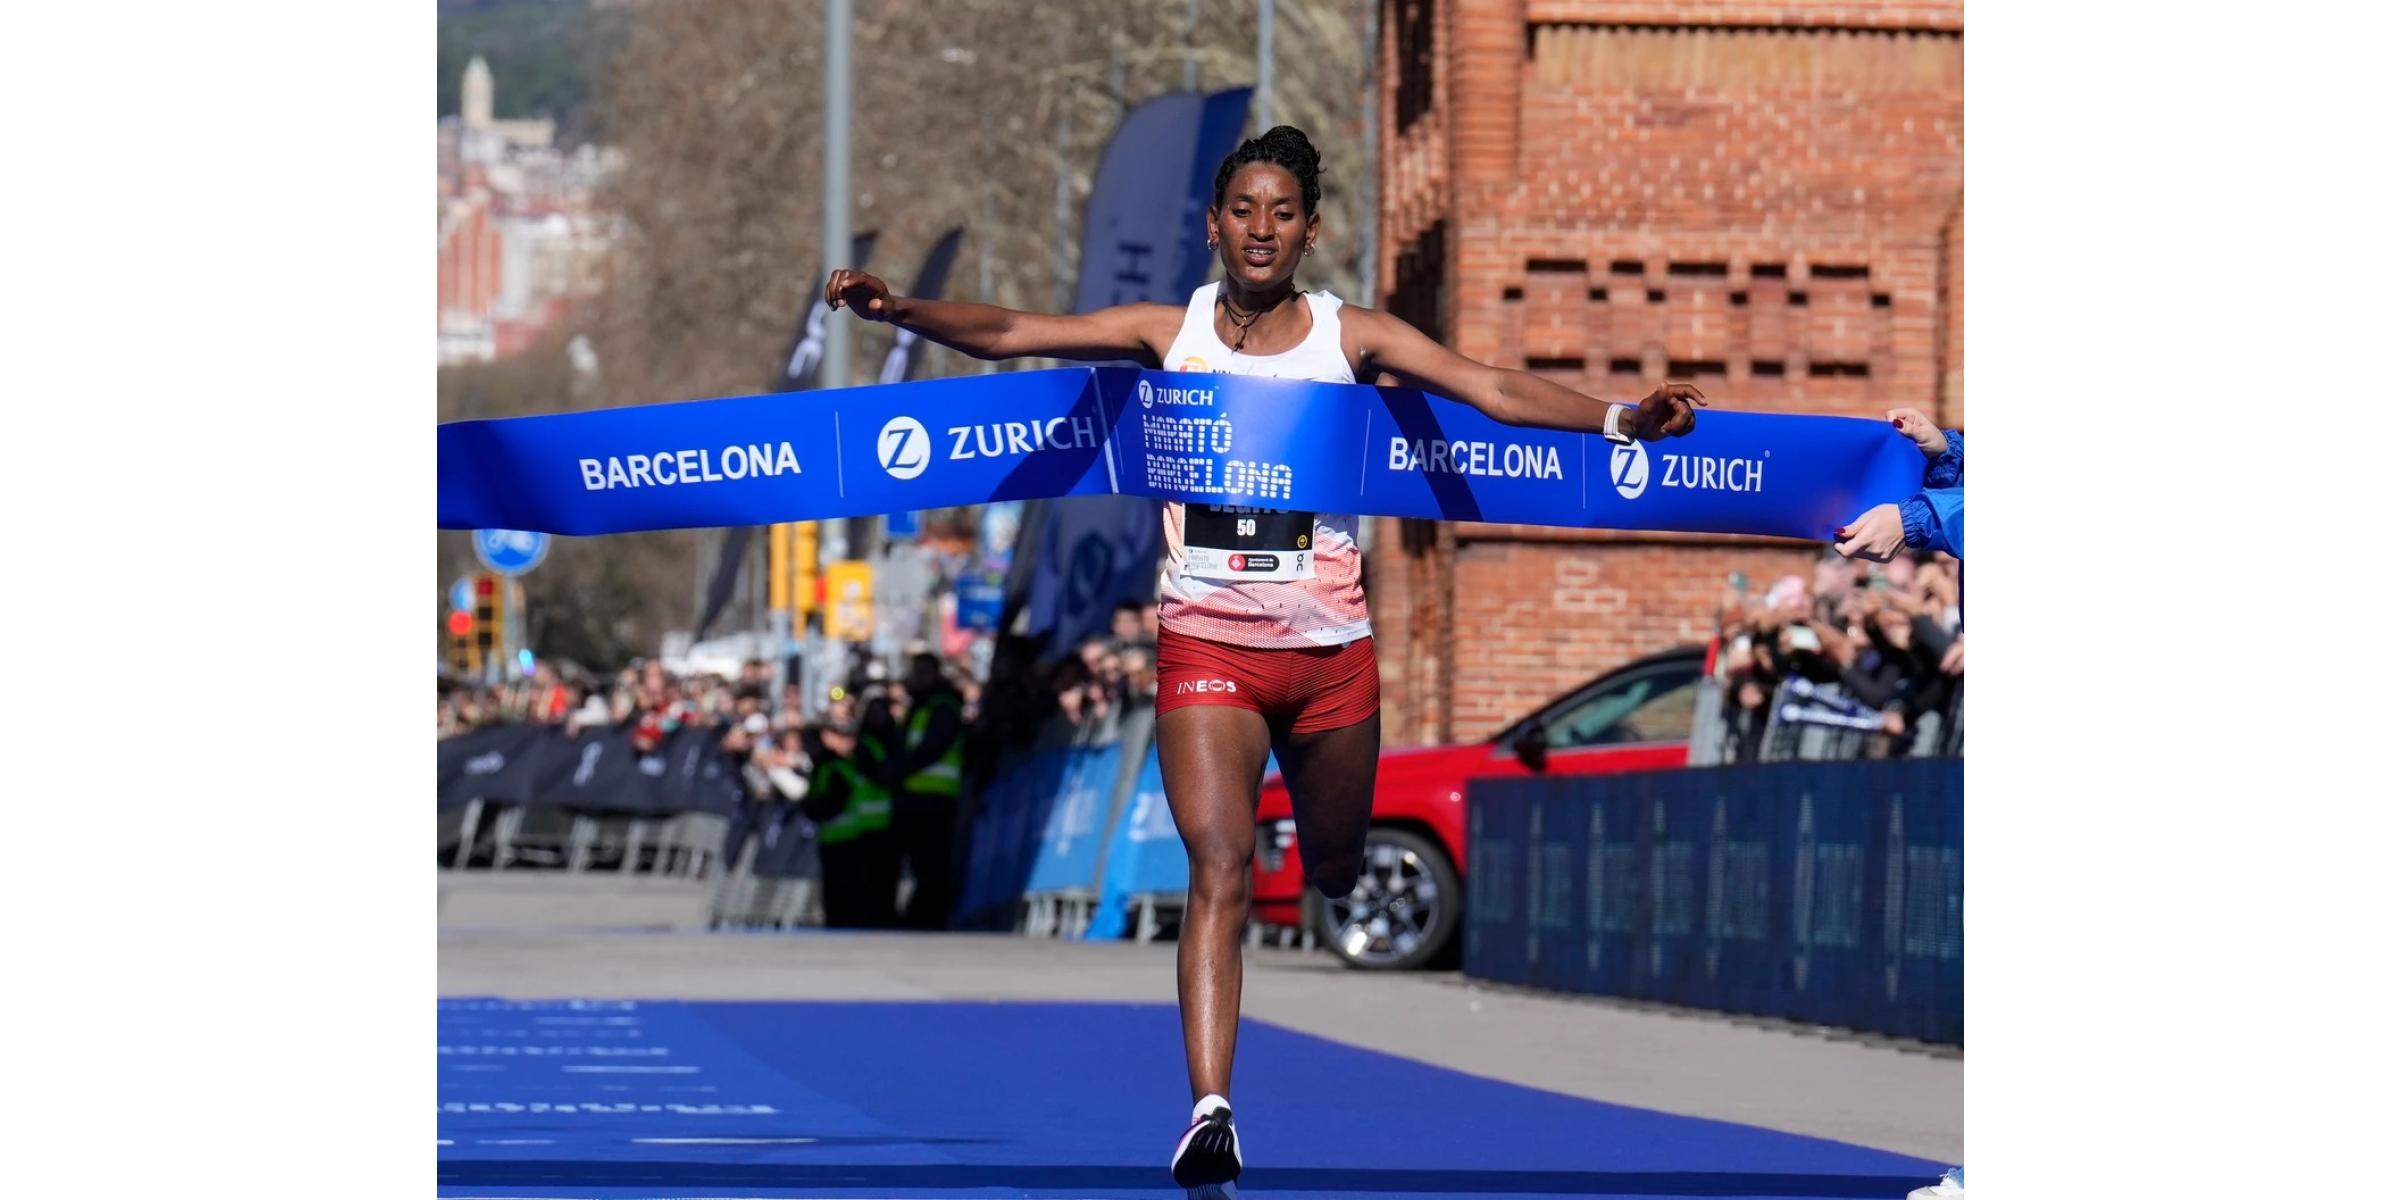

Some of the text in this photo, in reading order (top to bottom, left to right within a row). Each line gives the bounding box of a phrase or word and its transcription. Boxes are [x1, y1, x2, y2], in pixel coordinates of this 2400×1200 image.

[1156, 387, 1214, 406] ZURICH
[947, 416, 1097, 460] ZURICH
[1142, 411, 1233, 454] MARATÓ
[578, 441, 803, 491] BARCELONA
[1145, 453, 1293, 499] BARCELONA
[1388, 436, 1564, 480] BARCELONA
[1661, 454, 1764, 492] ZURICH
[1236, 518, 1257, 537] 50
[1177, 680, 1237, 695] INEOS
